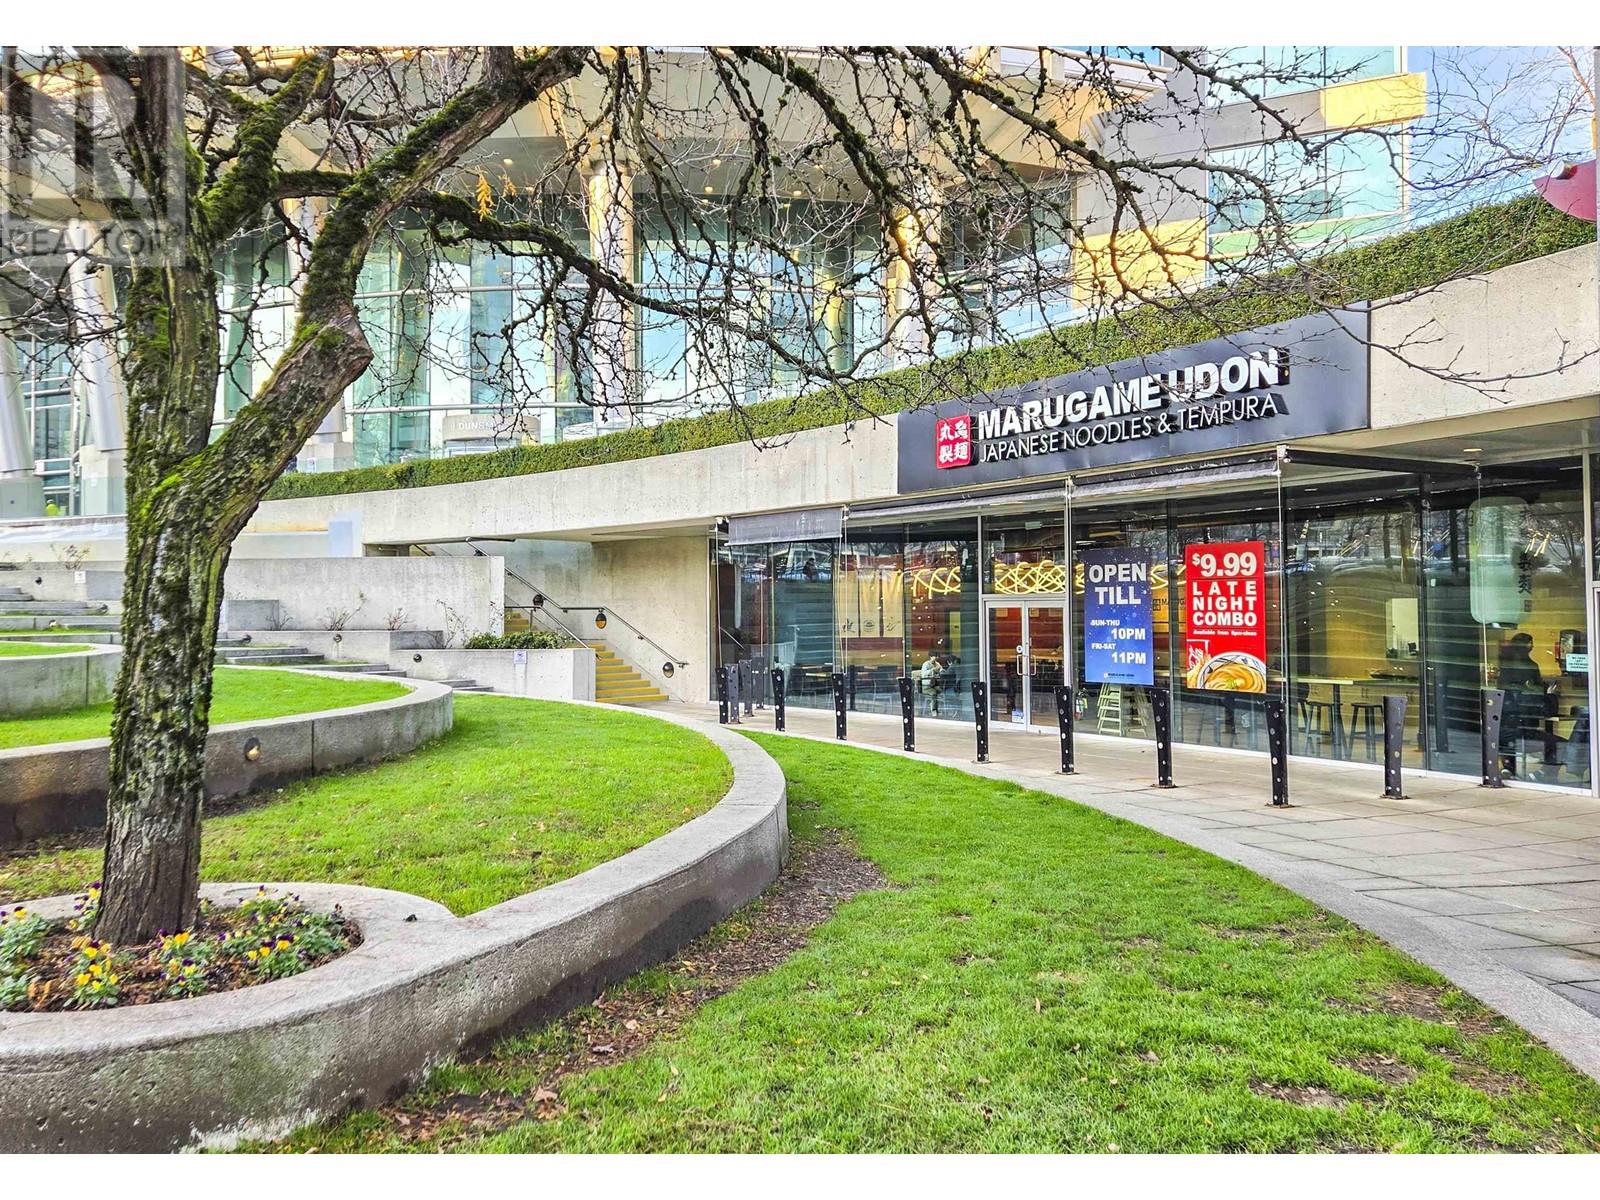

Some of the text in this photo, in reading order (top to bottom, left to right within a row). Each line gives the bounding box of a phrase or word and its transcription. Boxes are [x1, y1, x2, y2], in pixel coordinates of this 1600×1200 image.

[978, 347, 1279, 441] MARUGAME UDON
[979, 392, 1279, 463] JAPANESE NOODLES & TEMPURA
[1191, 551, 1258, 577] $9.99
[1088, 562, 1147, 584] OPEN
[1094, 585, 1142, 605] TILL
[1192, 580, 1258, 596] LATE
[1192, 596, 1258, 611] NIGHT
[1090, 619, 1121, 627] SUN-THU
[1192, 611, 1258, 627] COMBO
[1111, 627, 1146, 640] 10PM
[1091, 642, 1117, 650] FRI-SAT
[1111, 651, 1147, 665] 11PM
